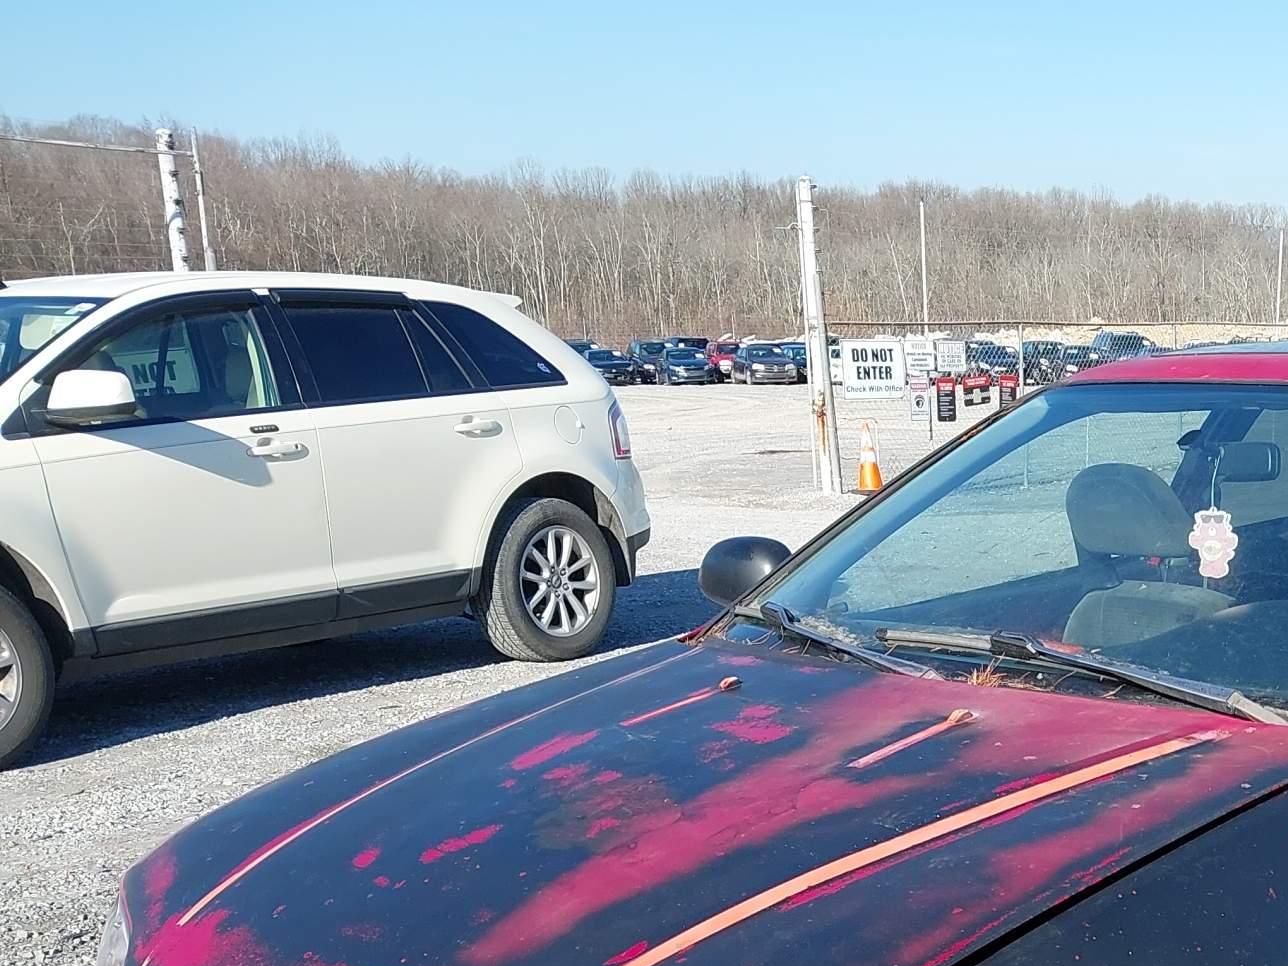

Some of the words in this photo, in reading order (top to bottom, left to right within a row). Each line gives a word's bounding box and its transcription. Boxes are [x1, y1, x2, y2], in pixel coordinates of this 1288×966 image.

[851, 348, 869, 363] DO
[871, 348, 894, 362] NOT
[856, 365, 893, 380] ENTER
[846, 385, 866, 393] Check
[868, 385, 883, 393] With
[884, 385, 904, 393] Office
